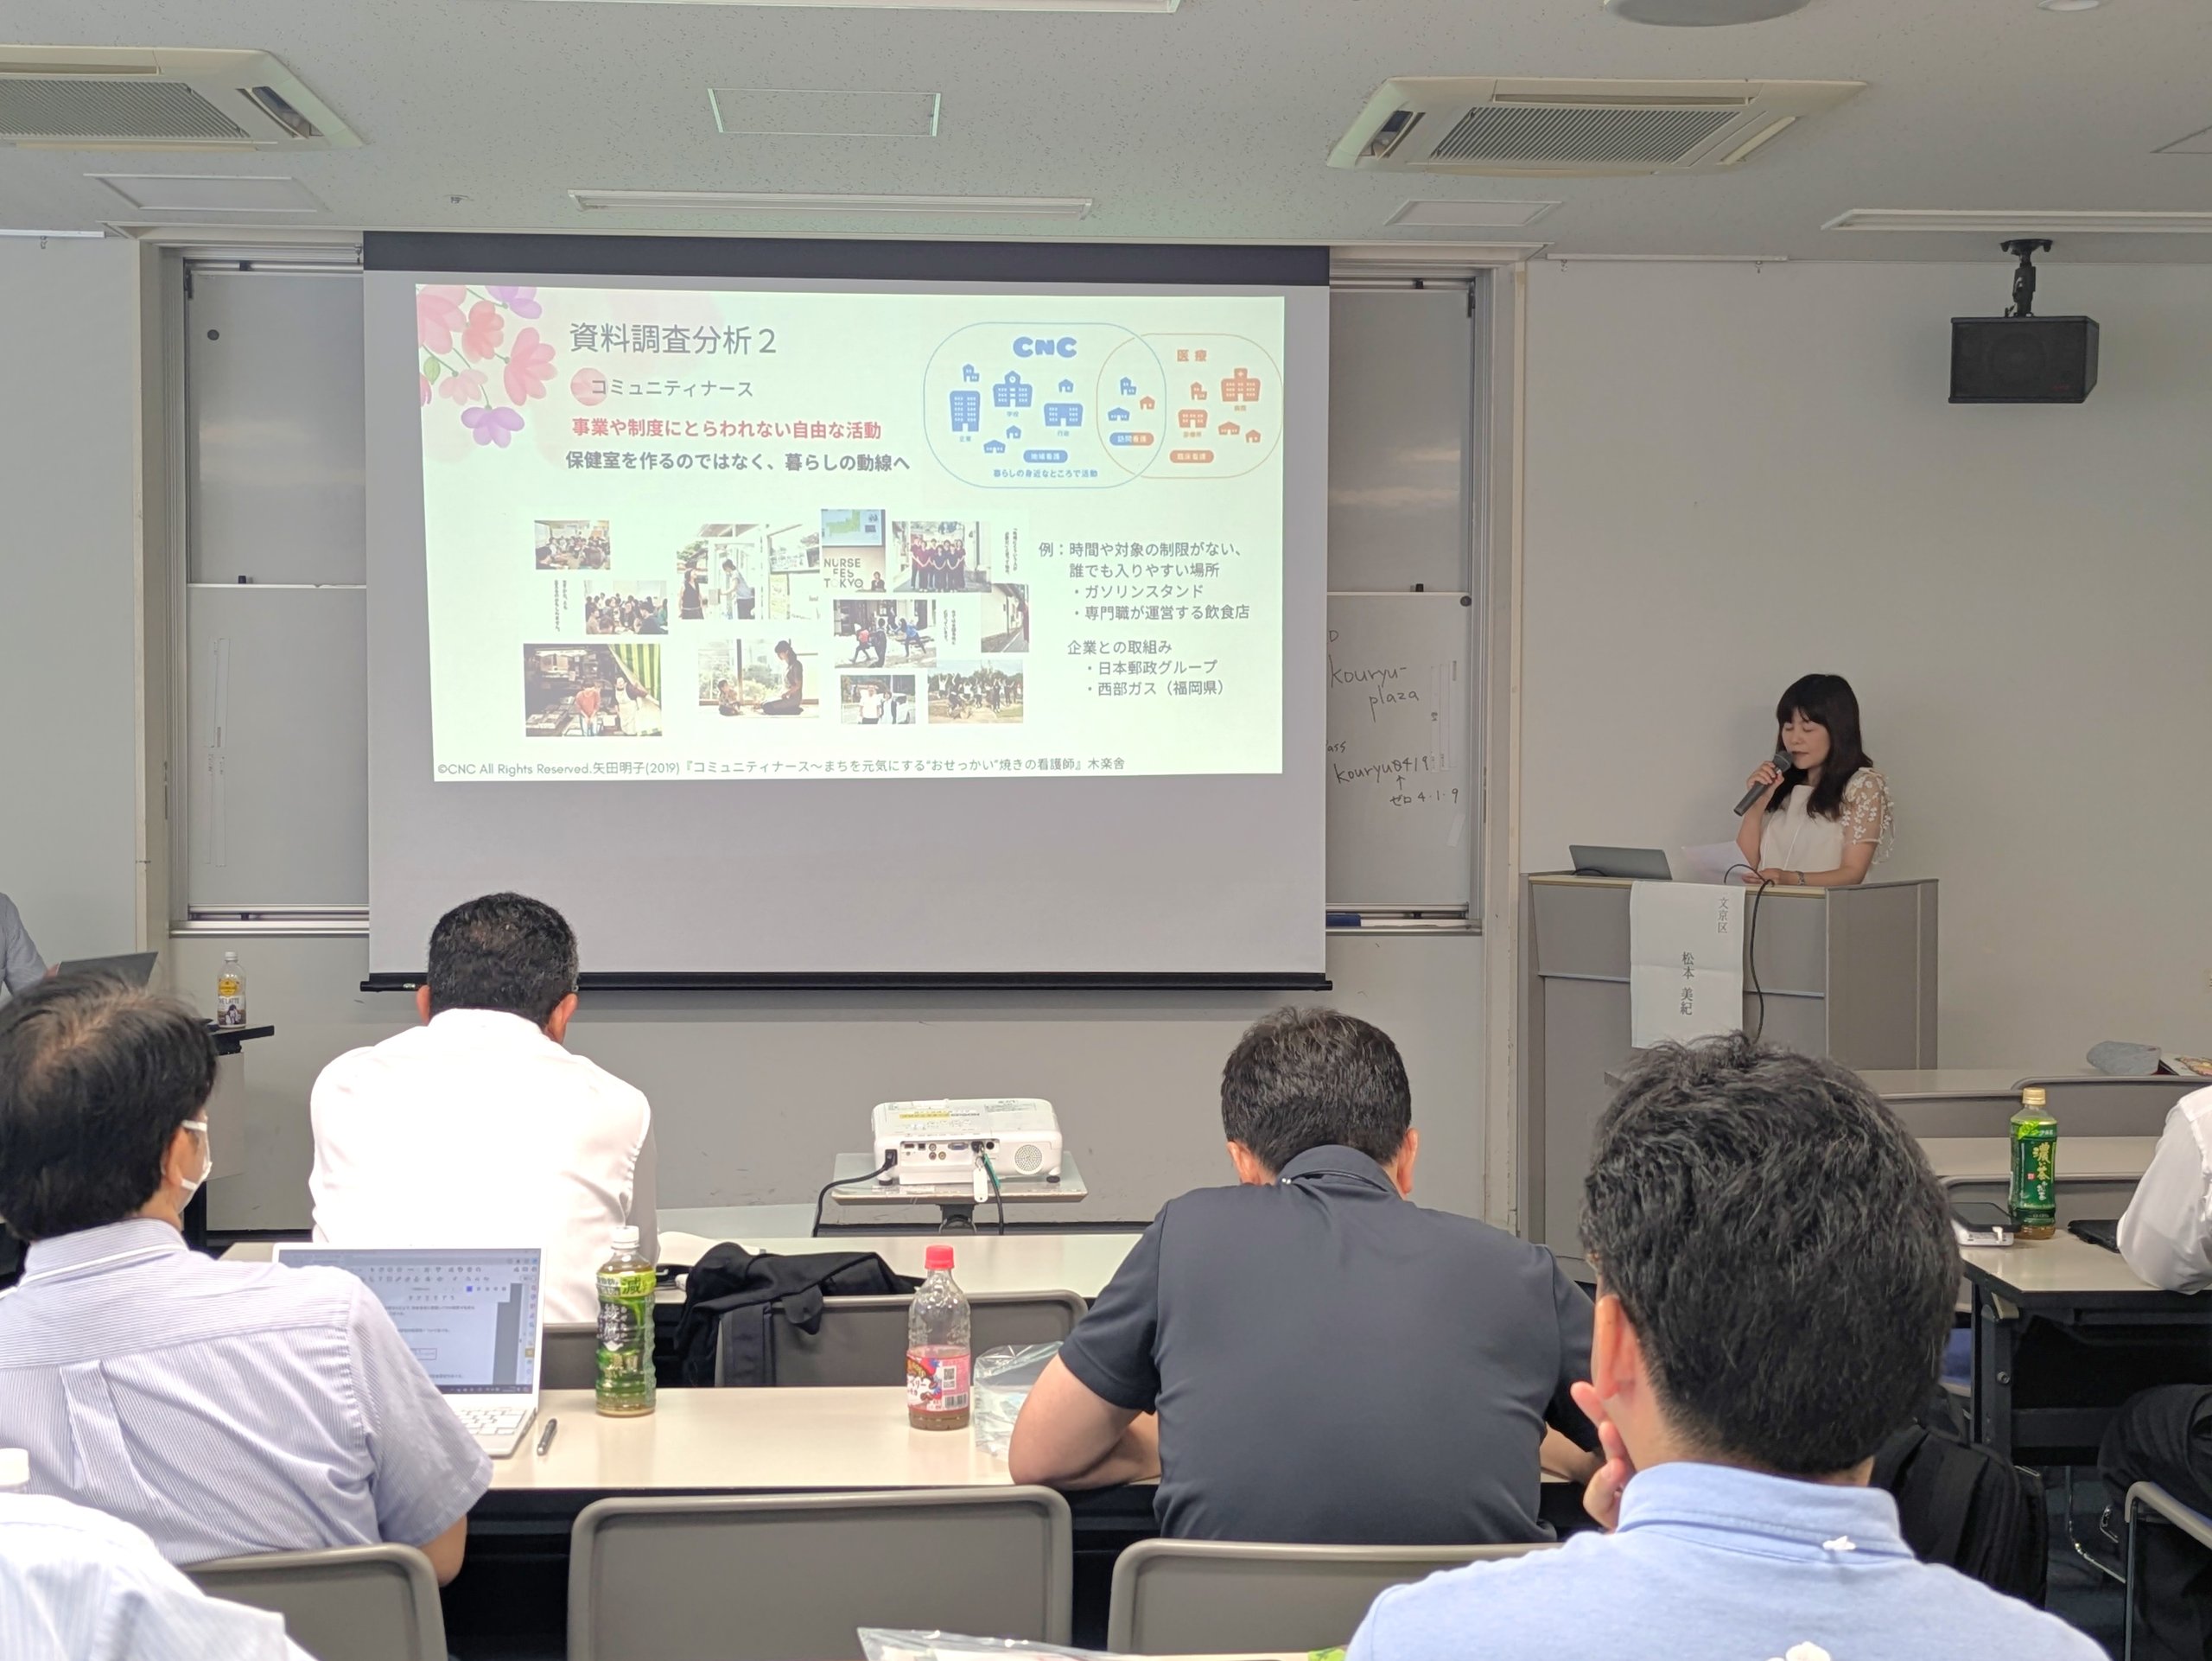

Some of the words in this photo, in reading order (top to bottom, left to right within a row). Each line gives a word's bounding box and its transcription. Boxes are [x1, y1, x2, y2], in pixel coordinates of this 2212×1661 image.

[569, 321, 777, 355] 資料調査分析2
[1012, 336, 1077, 358] CNC
[591, 378, 753, 398] コミュニティナース
[571, 417, 882, 441] 事業や制度にとらわれない自由な活動
[565, 450, 911, 473] 保健室を作るのではなく、暮らしの動線へ
[993, 469, 1098, 478] 暮らしの身近なところで活動
[823, 557, 861, 568] NURSE
[1069, 562, 1220, 578] 誰でも入りやすい場所
[1067, 640, 1173, 655] 企業との取組み
[1369, 684, 1420, 722] plaza
[1326, 740, 1346, 753] ass
[479, 763, 494, 774] All
[498, 762, 533, 777] Rights
[1718, 897, 1729, 933] 文京区
